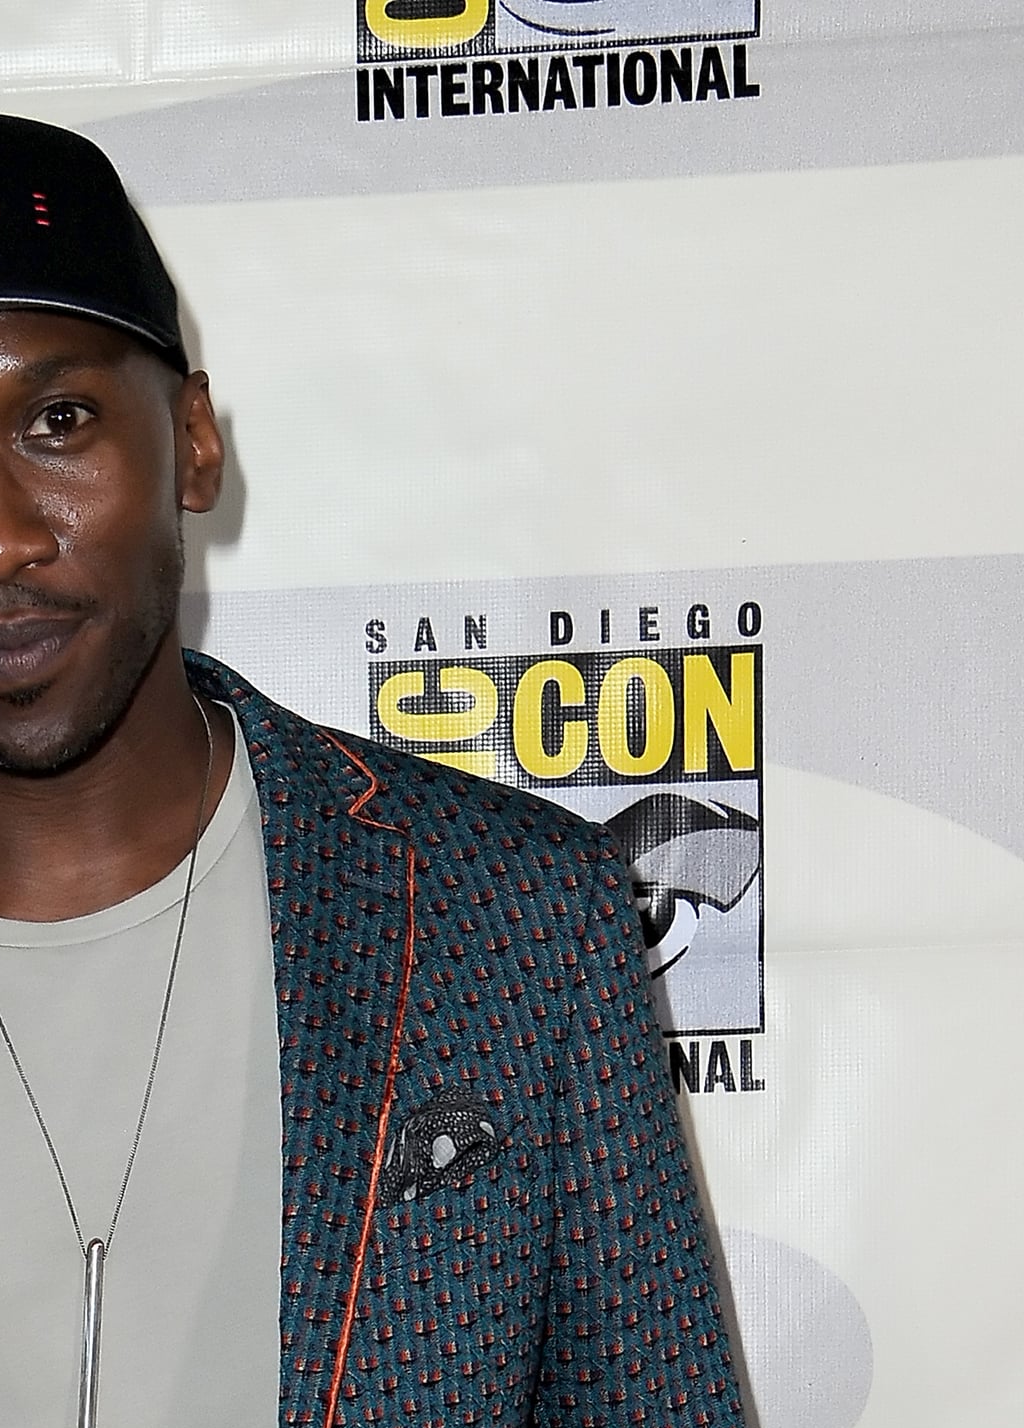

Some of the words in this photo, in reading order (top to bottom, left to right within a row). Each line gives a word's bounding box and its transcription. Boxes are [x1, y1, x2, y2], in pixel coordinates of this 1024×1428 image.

[357, 45, 760, 122] INTERNATIONAL
[366, 614, 488, 654] SAN
[550, 602, 763, 647] DIEGO
[513, 652, 757, 779] CON
